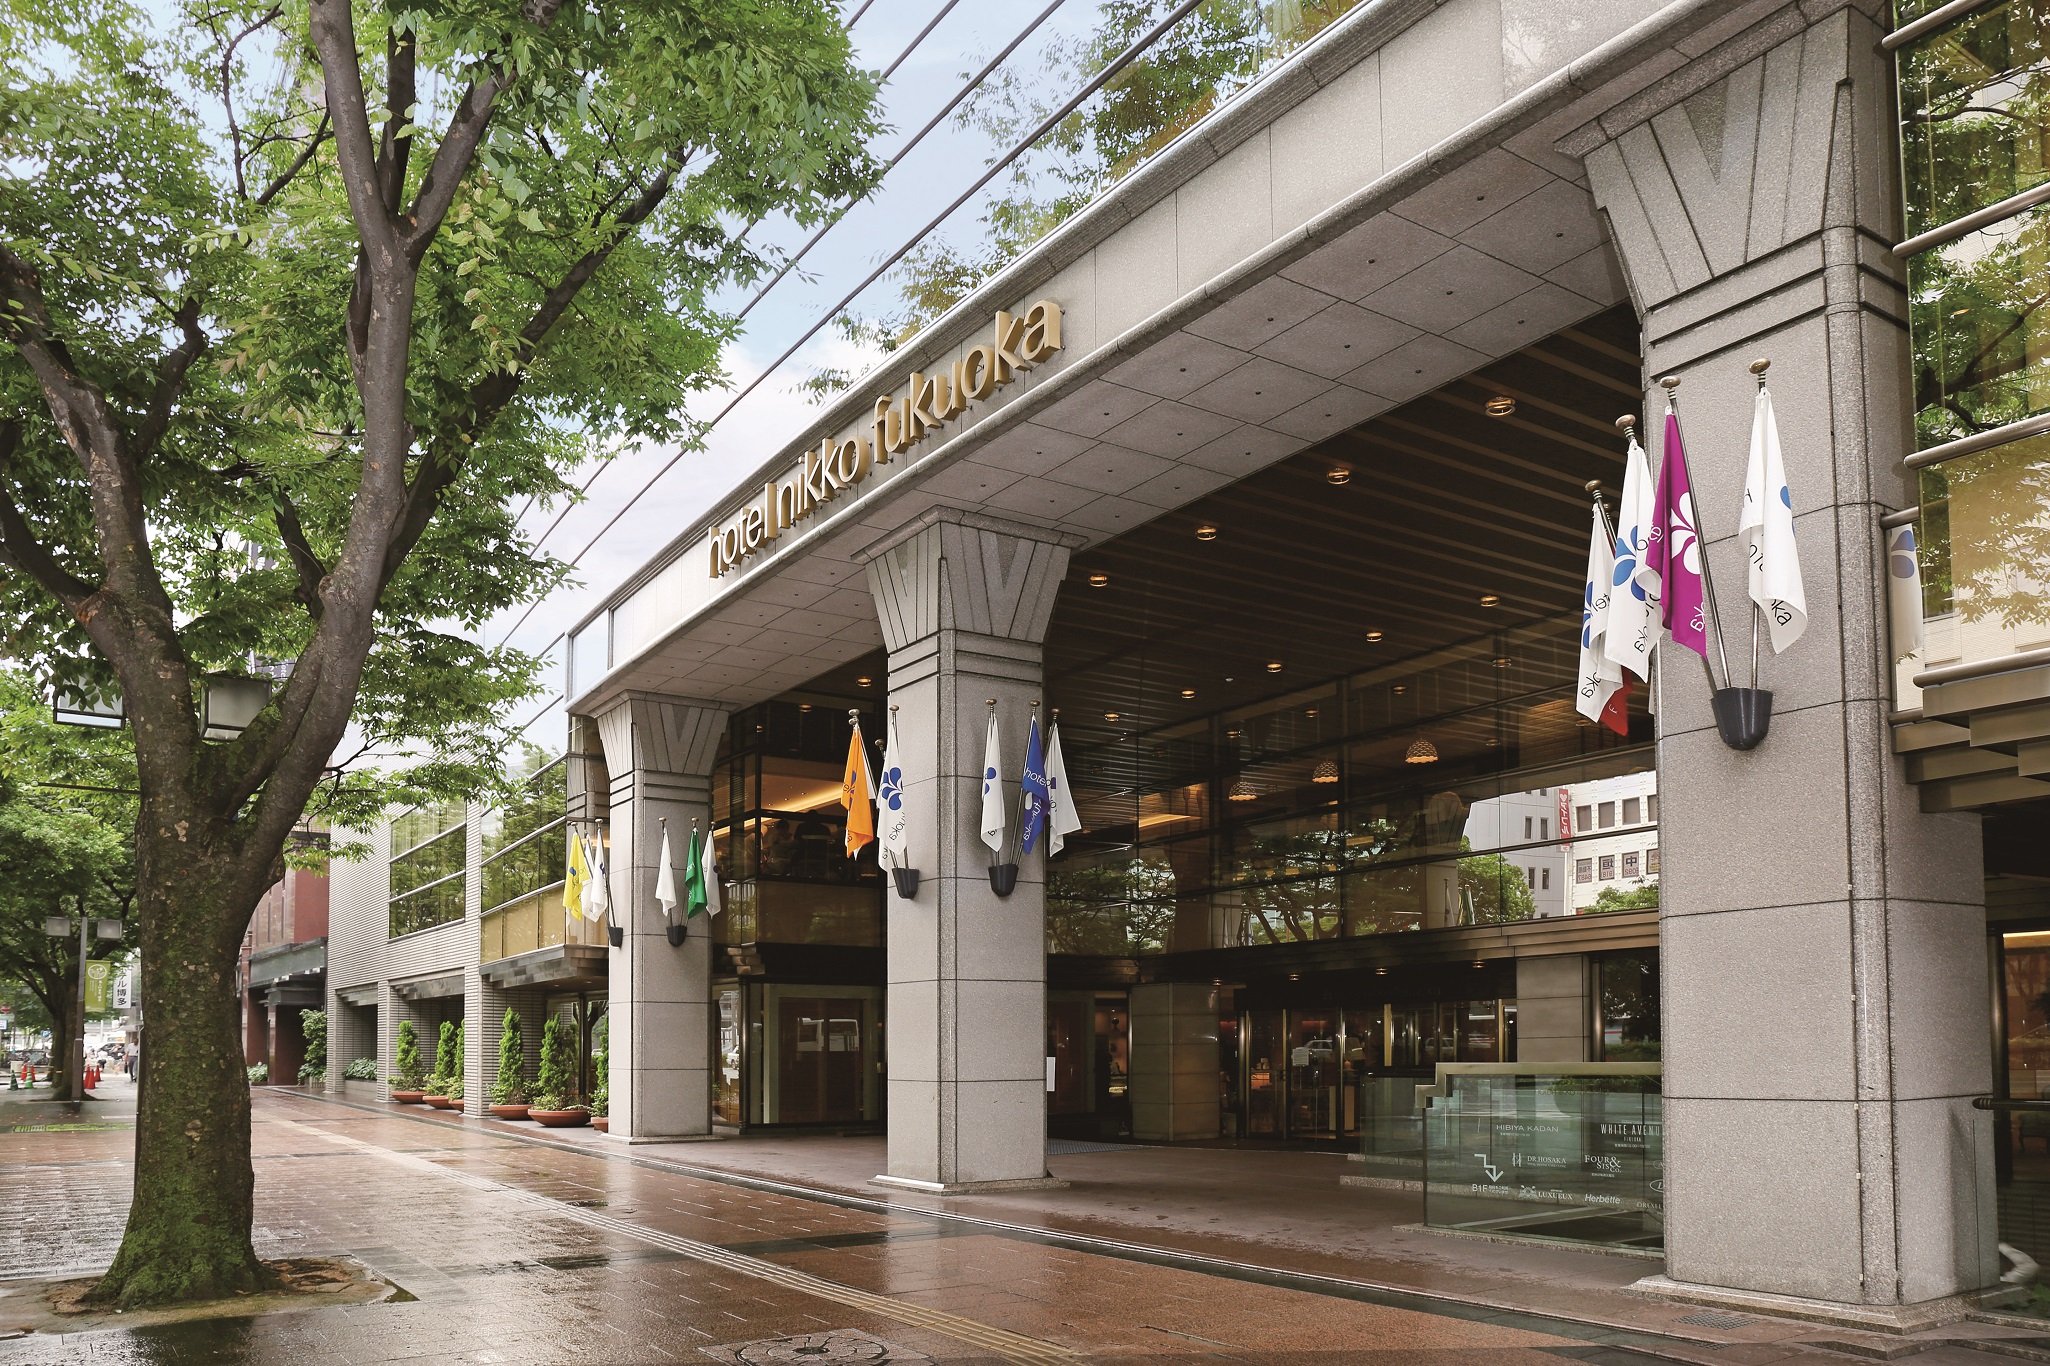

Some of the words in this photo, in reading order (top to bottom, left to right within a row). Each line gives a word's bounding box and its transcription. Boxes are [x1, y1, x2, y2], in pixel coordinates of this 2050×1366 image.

[709, 482, 778, 579] hotel
[777, 438, 870, 529] nikko
[871, 300, 1062, 465] fukuoka
[1527, 1125, 1559, 1133] KADAN
[1600, 1123, 1627, 1135] WHITE
[1631, 1124, 1660, 1136] AVENU
[1472, 1183, 1488, 1192] B1F
[1584, 1193, 1621, 1204] Herbette
